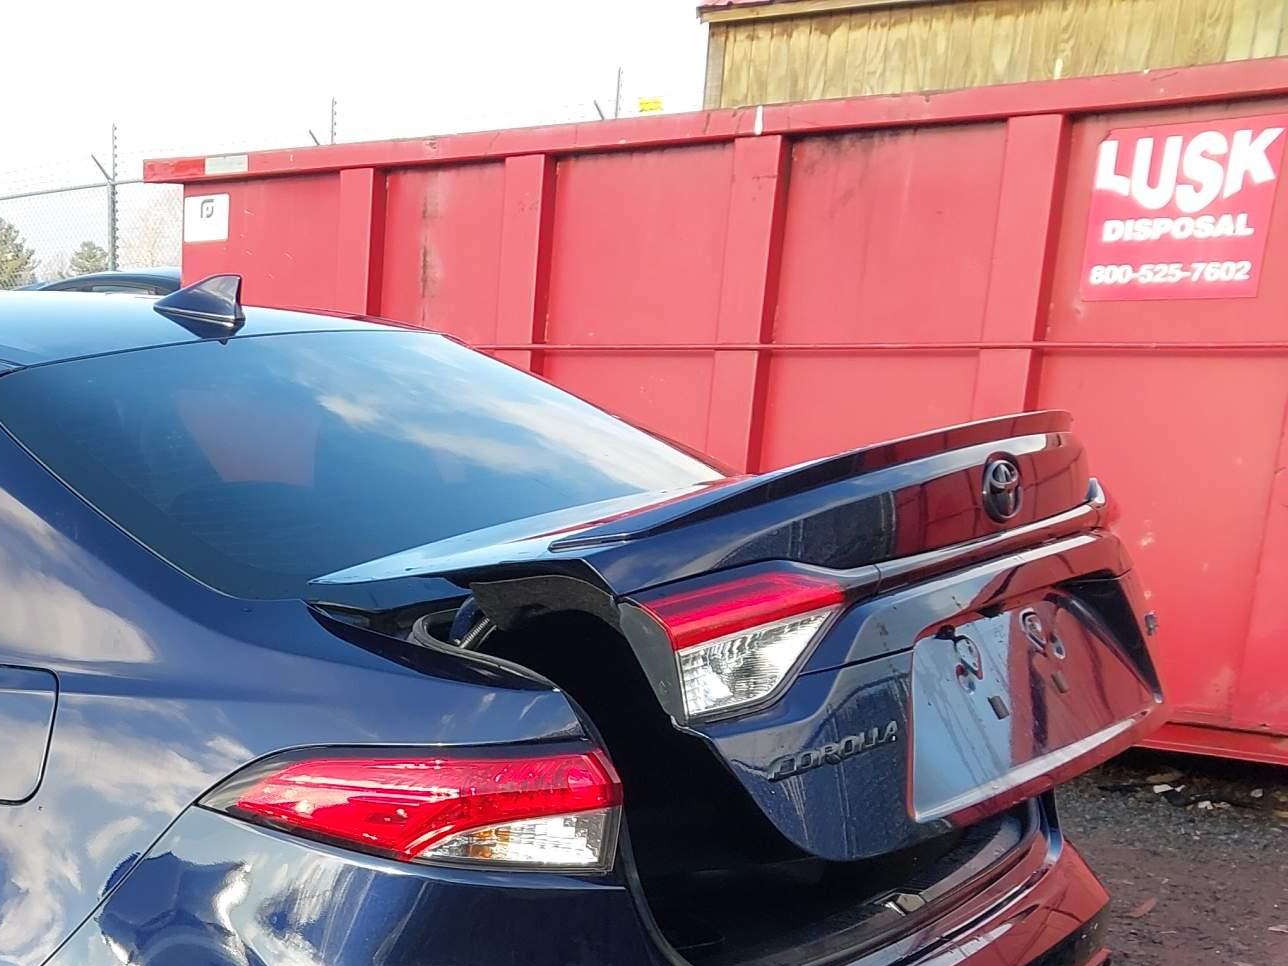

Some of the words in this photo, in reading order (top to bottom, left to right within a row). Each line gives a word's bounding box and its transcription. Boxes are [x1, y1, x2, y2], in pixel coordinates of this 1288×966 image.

[1096, 127, 1285, 213] LUSK
[1101, 212, 1255, 243] DISPOSAL
[1089, 260, 1252, 285] 800-525-7602
